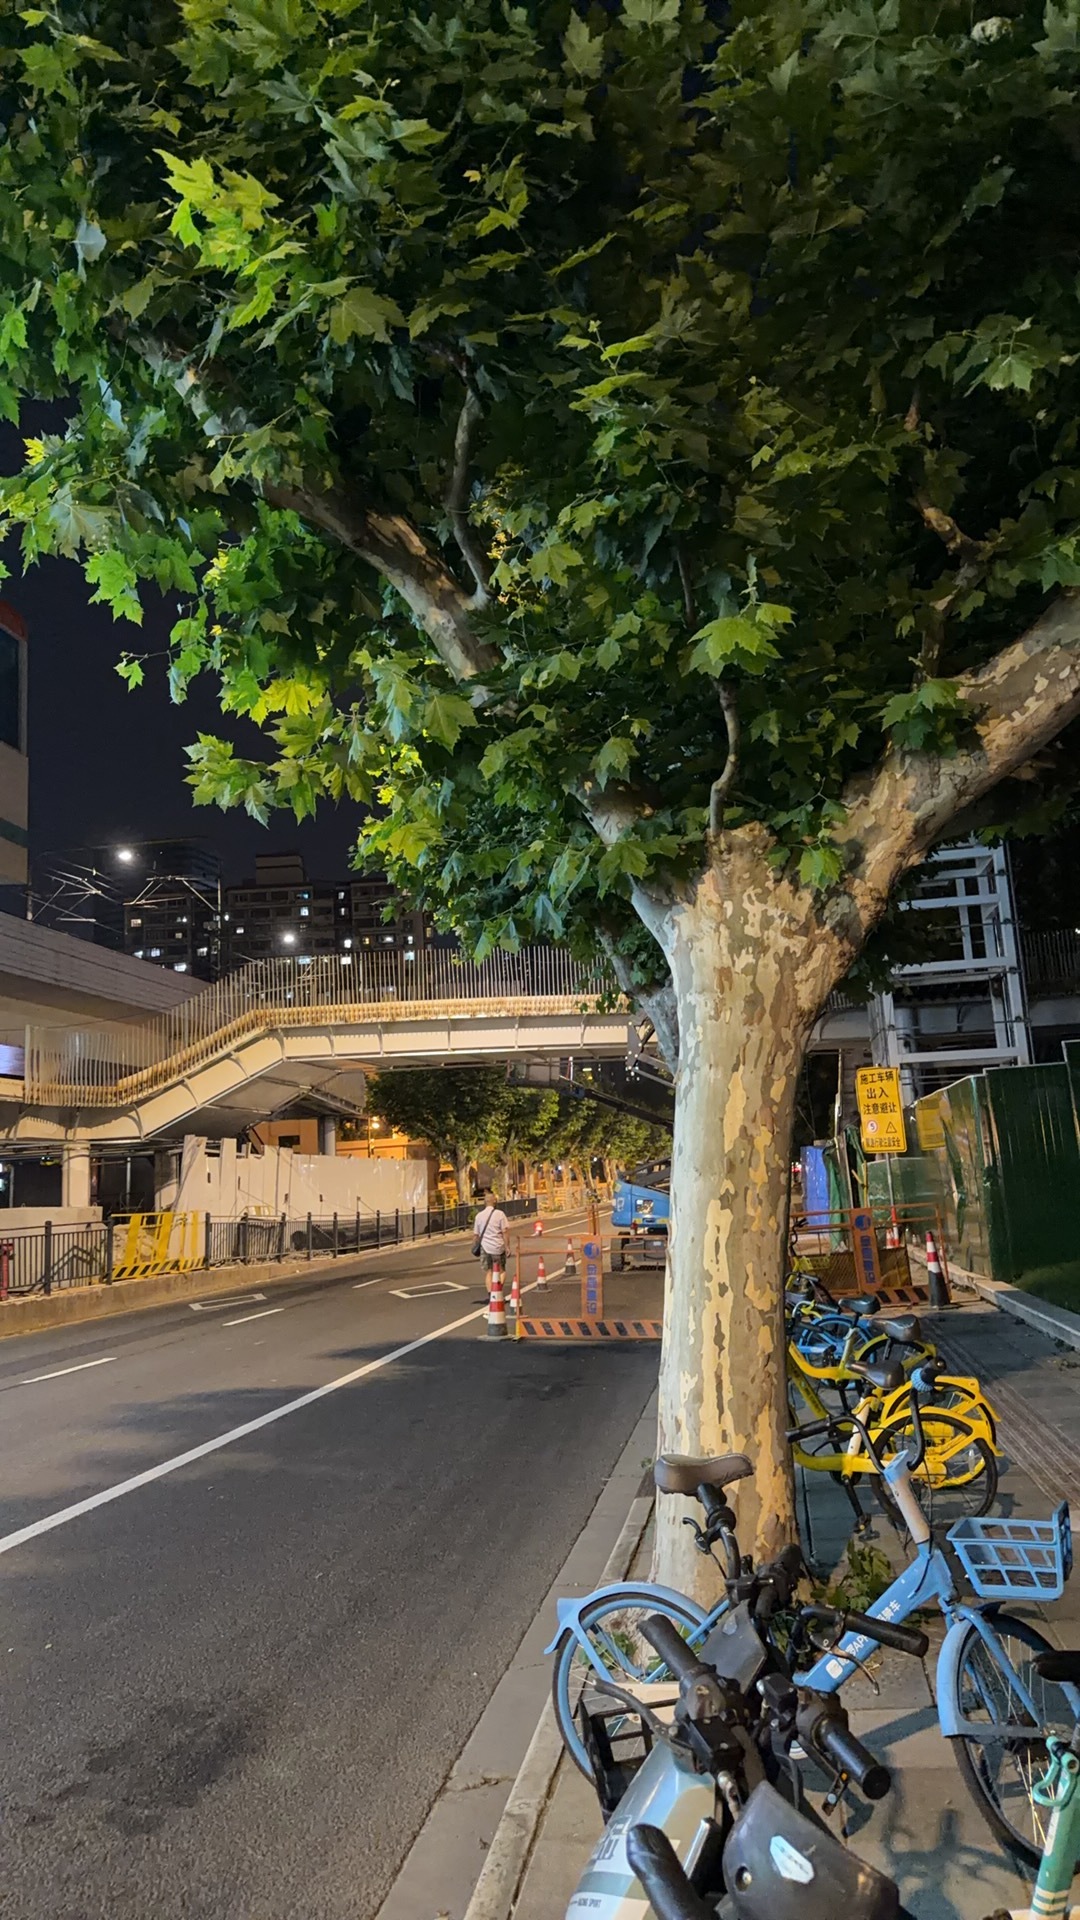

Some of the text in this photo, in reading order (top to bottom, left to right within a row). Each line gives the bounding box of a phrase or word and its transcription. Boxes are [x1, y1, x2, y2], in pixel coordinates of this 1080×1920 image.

[860, 1070, 894, 1085] 施工车辆
[866, 1087, 889, 1099] 出入
[863, 1102, 898, 1115] 注意避让
